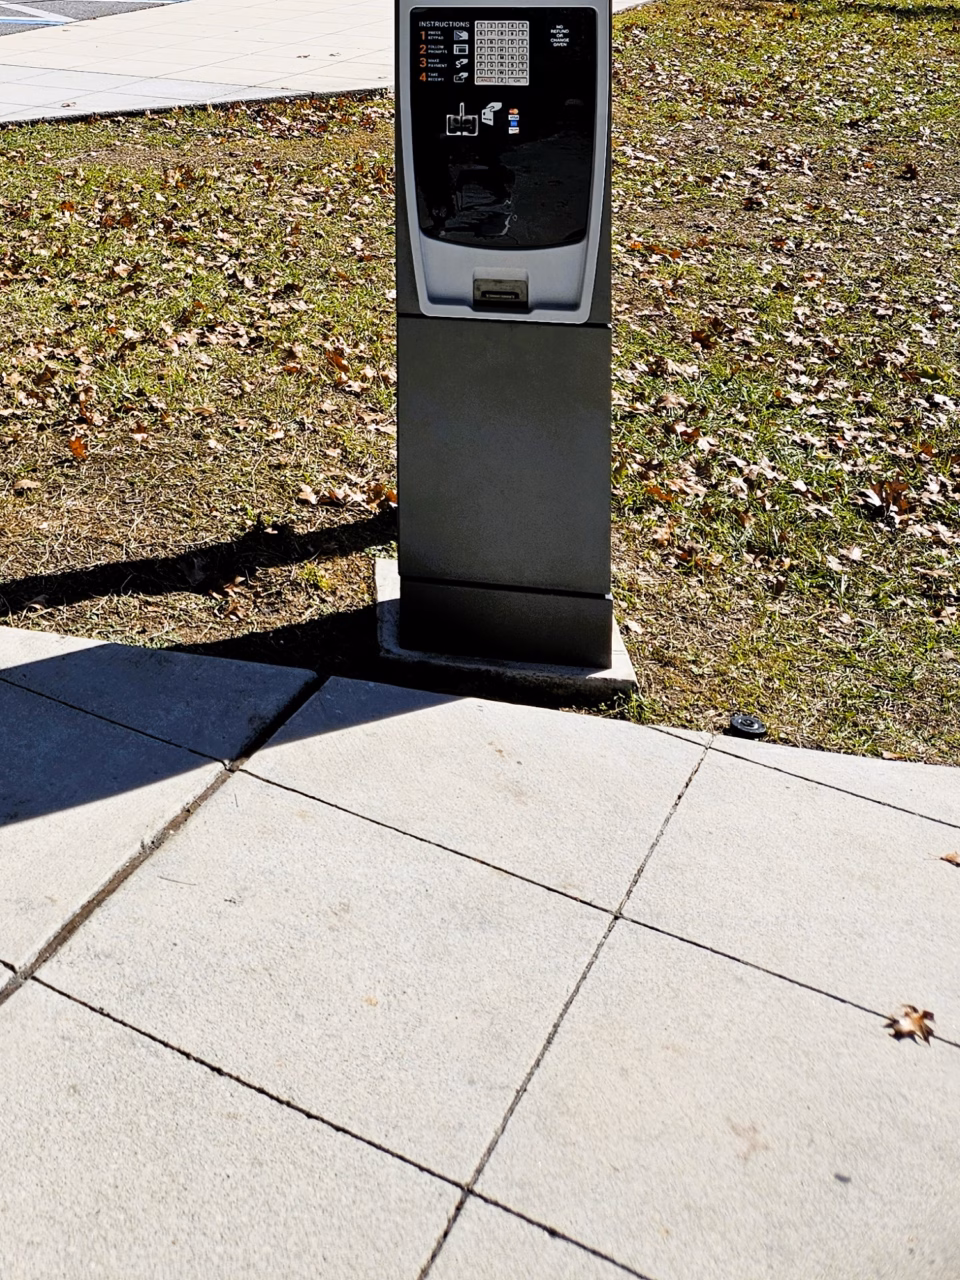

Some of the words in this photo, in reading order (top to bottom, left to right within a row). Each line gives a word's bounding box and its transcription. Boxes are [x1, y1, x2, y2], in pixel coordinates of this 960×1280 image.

[420, 31, 425, 40] 1
[420, 45, 426, 54] 2
[420, 58, 427, 67] 3
[420, 72, 426, 81] 4
